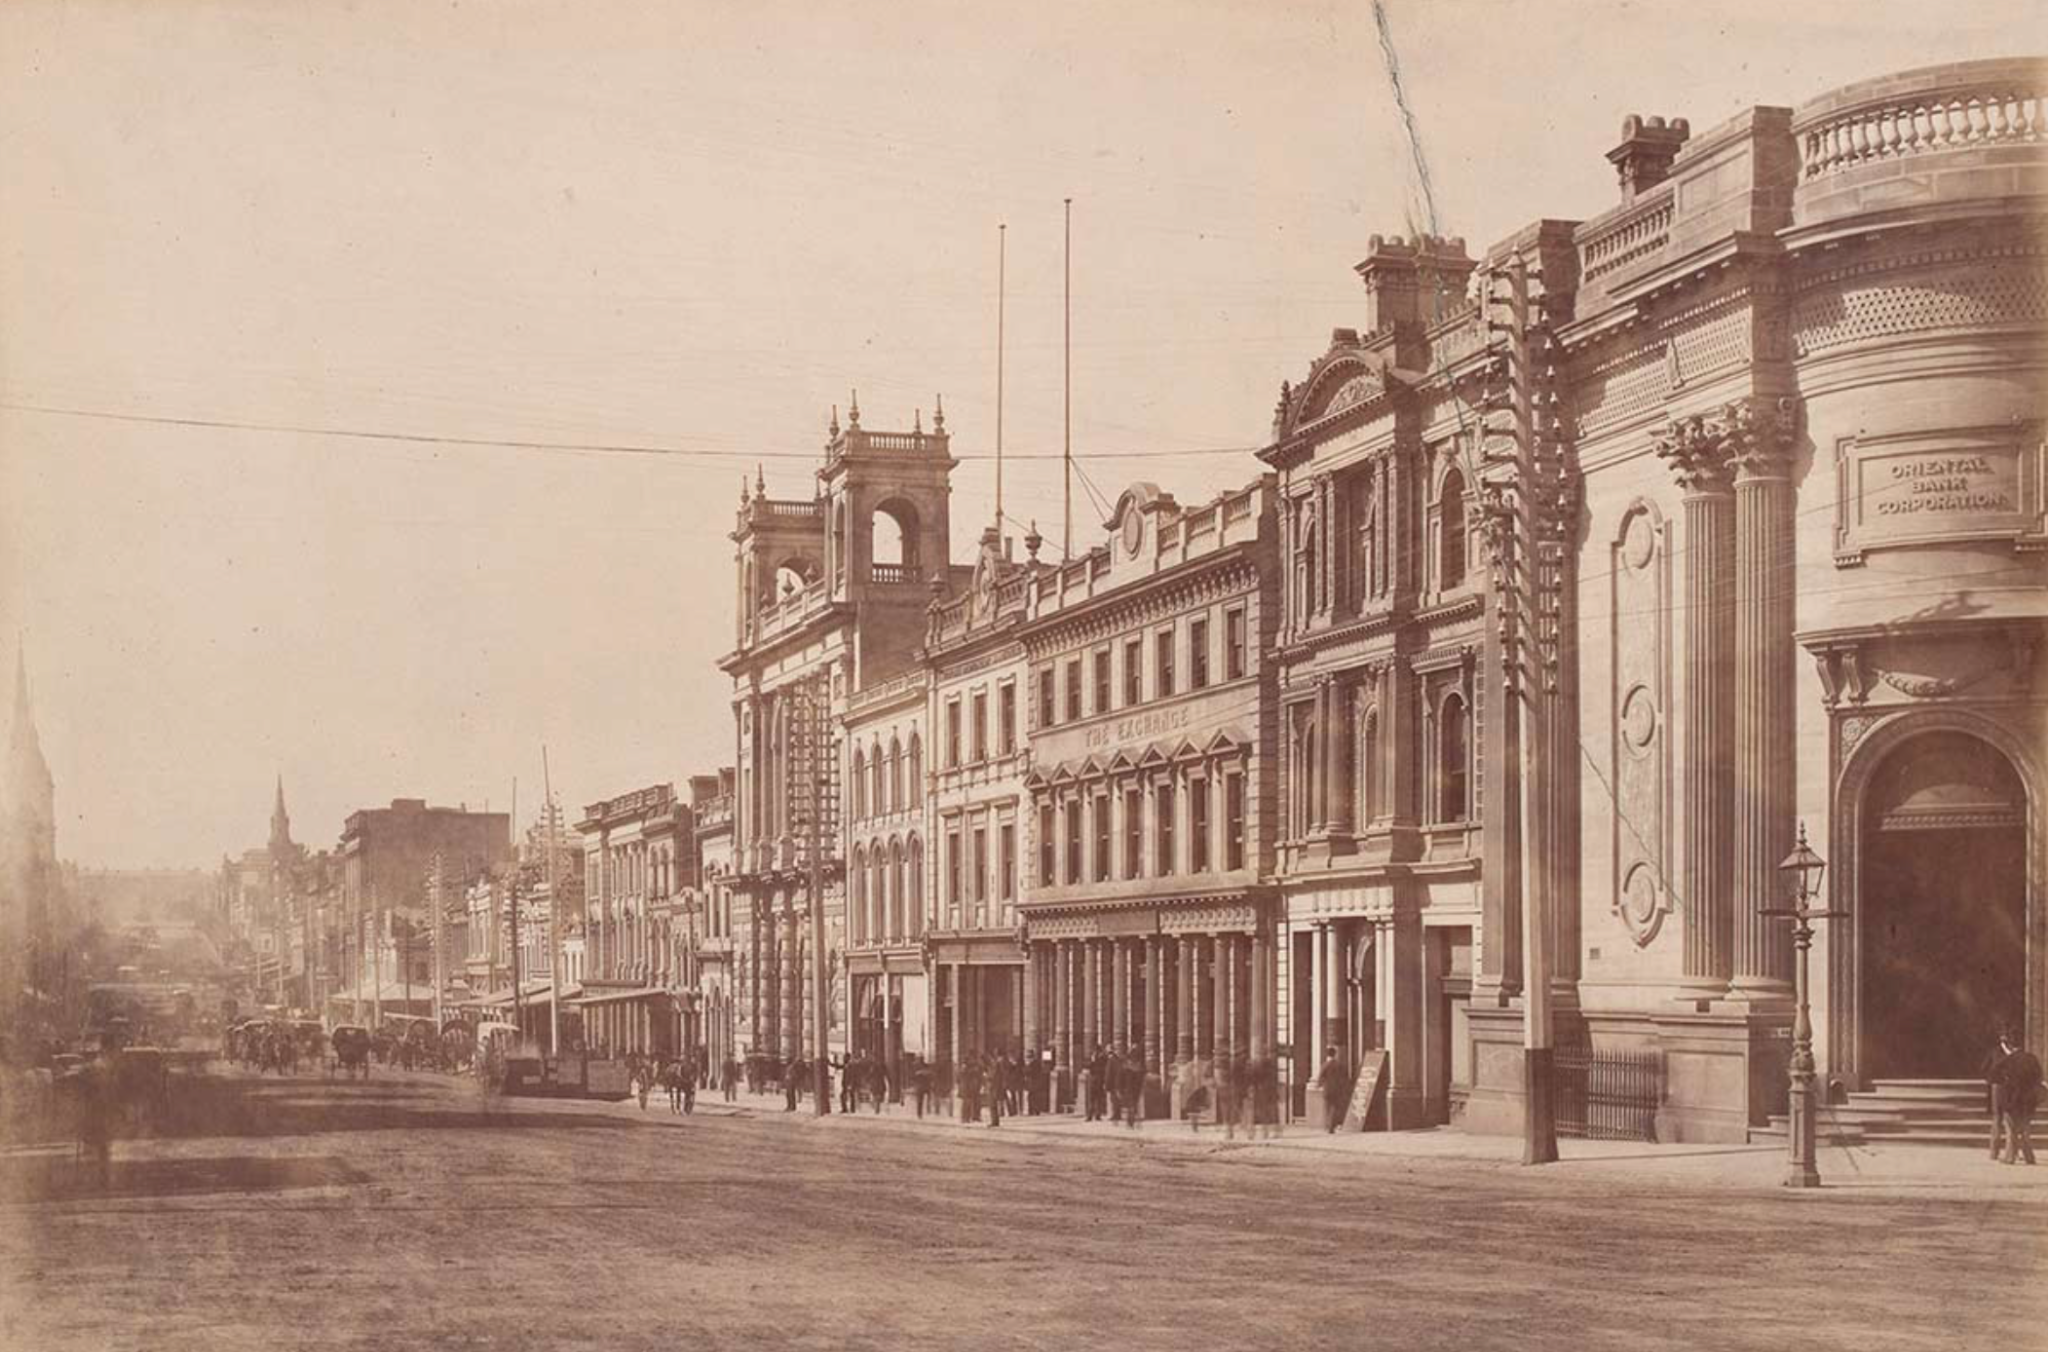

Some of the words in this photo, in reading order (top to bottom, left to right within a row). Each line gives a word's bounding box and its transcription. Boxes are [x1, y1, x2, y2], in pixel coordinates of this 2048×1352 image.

[1891, 459, 1992, 478] ORIENTAL
[1912, 478, 1968, 494] BANK
[1878, 494, 2006, 514] CORPORATION
[1085, 725, 1109, 747] THE
[1118, 706, 1188, 740] EXCHANGE
